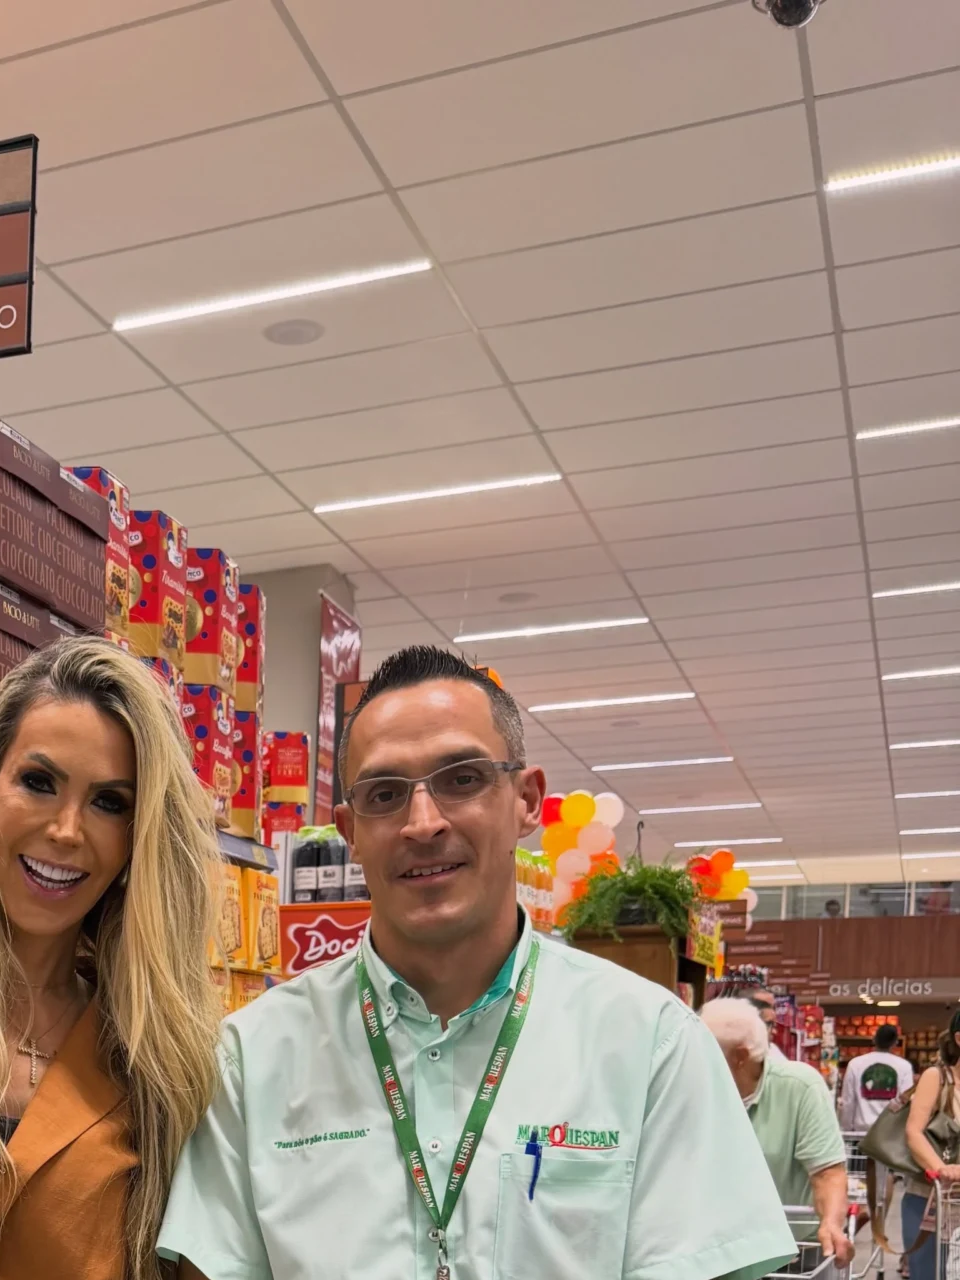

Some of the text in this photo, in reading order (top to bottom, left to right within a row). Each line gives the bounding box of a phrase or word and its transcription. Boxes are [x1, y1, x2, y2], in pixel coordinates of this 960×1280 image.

[303, 930, 365, 961] Doci
[829, 977, 933, 997] as delícias
